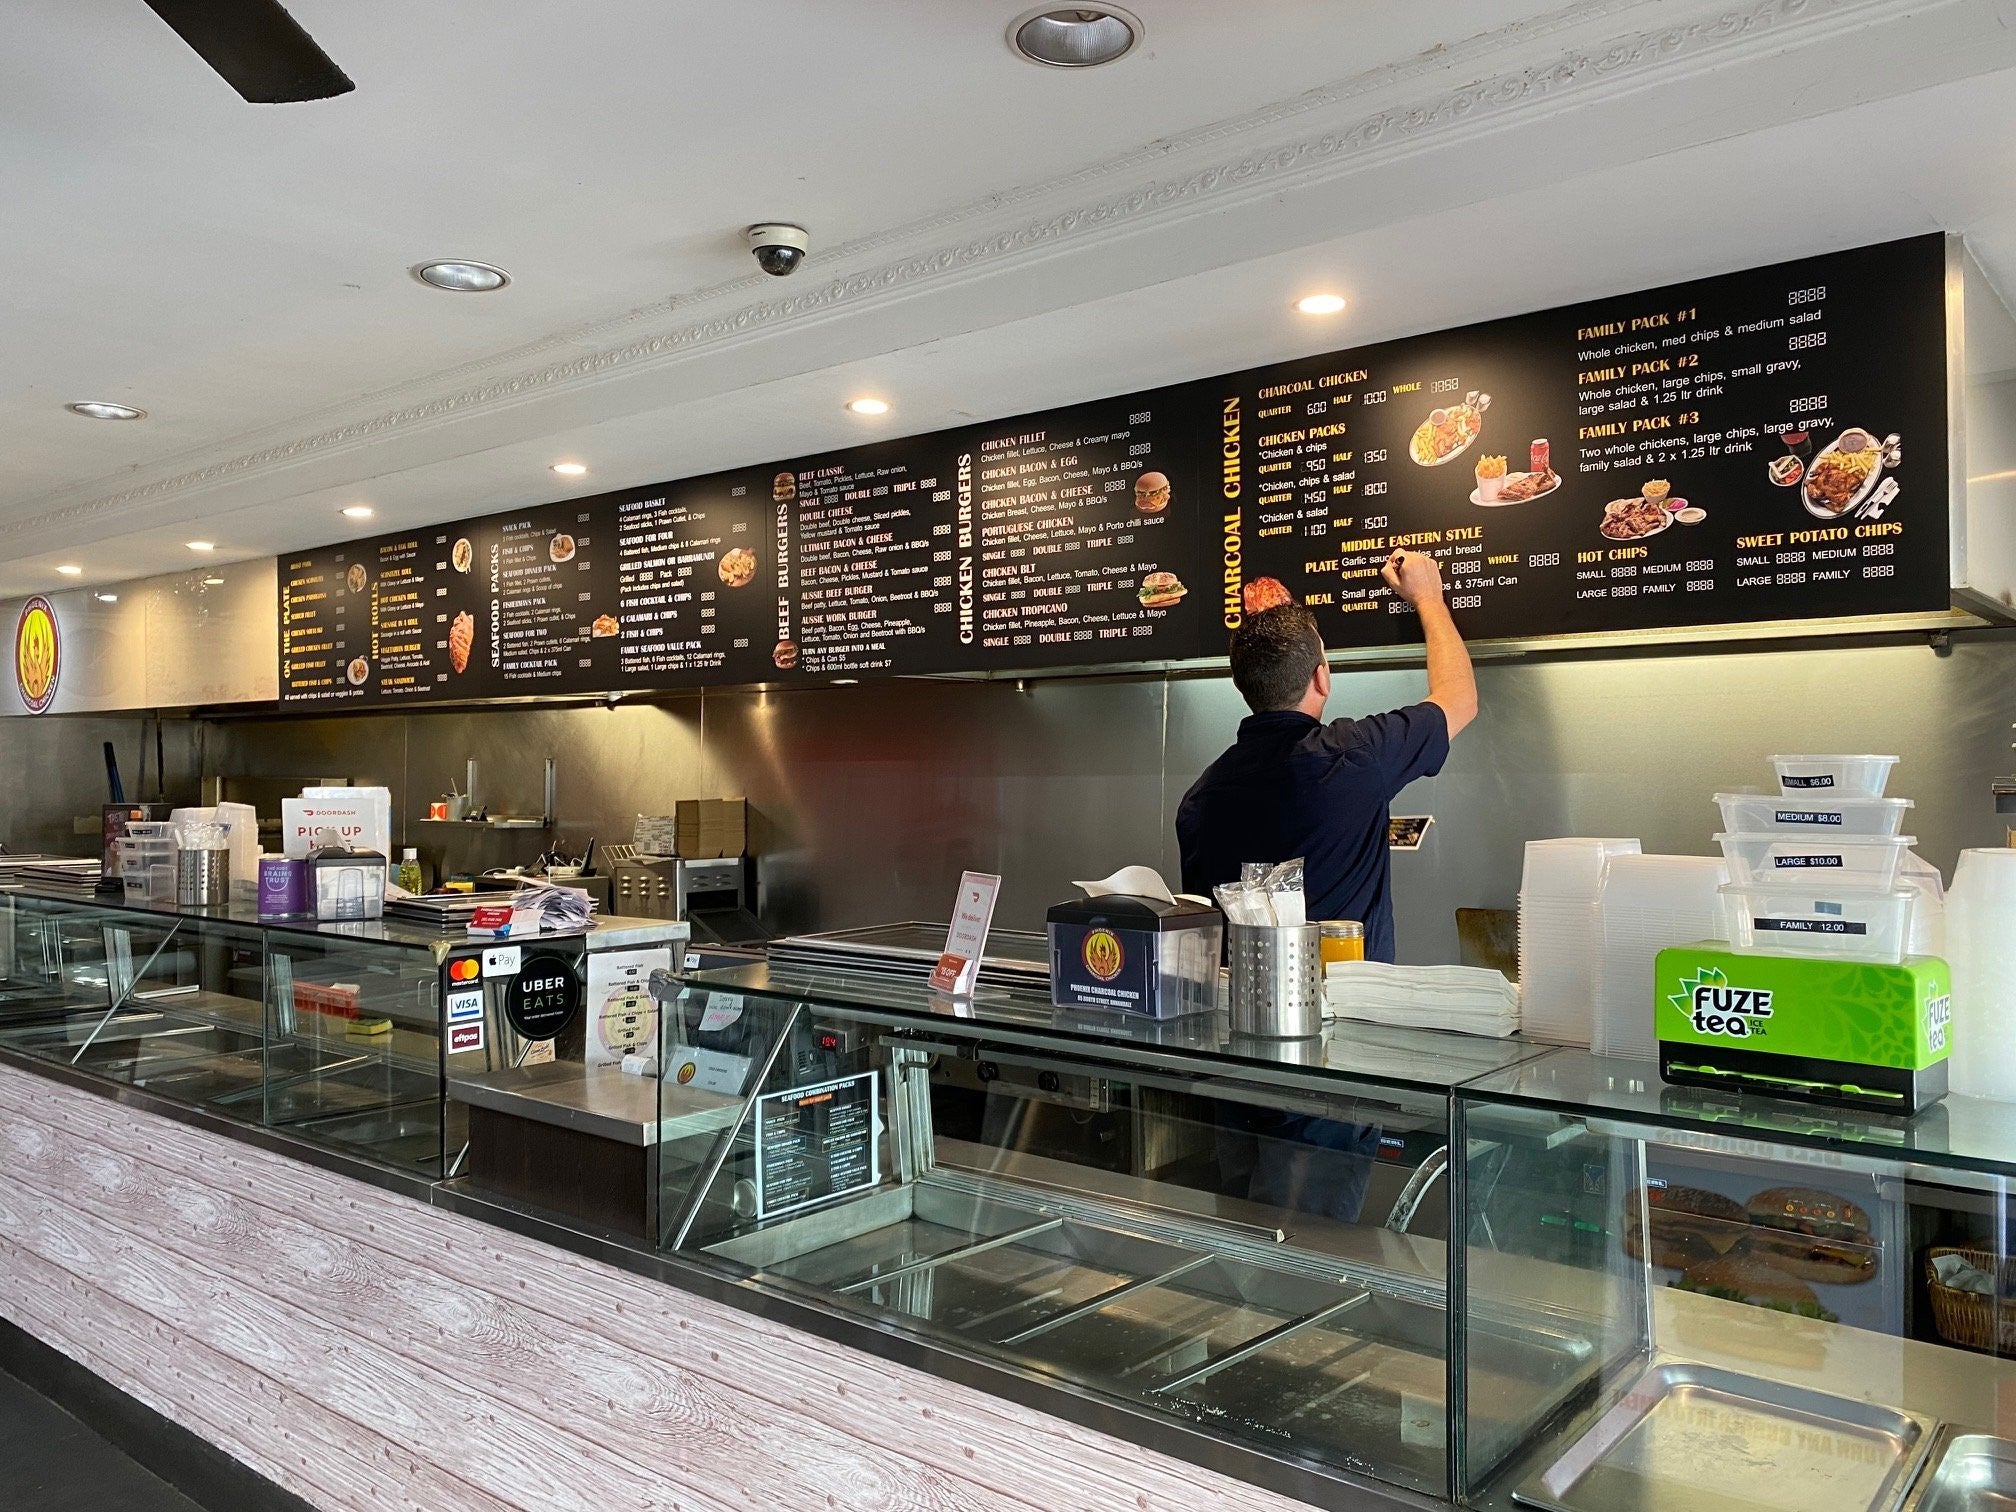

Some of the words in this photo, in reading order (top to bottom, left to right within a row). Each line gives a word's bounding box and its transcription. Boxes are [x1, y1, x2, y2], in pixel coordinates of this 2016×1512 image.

[1577, 320, 1626, 340] FAMILY
[1631, 313, 1670, 331] PACK
[1677, 308, 1697, 322] #1
[1578, 347, 1610, 362] Whole
[1615, 340, 1657, 358] chicken,
[1662, 332, 1687, 348] med
[1690, 328, 1720, 344] chips
[1724, 325, 1733, 336] &
[1738, 317, 1784, 335] medium
[1789, 310, 1822, 325] salad
[1578, 366, 1626, 384] FAMILY
[1632, 359, 1670, 376] PACK
[1678, 354, 1699, 367] #2
[1579, 388, 1611, 401] Whole
[1615, 381, 1658, 397] chicken,
[1662, 375, 1690, 390] large
[1694, 369, 1726, 385] chips,
[1731, 363, 1762, 378] small
[1766, 358, 1801, 374] gravy,
[1258, 381, 1314, 399] CHARCOAL
[1319, 370, 1367, 388] CHICKEN
[1258, 406, 1291, 419] QUARTER
[1333, 394, 1353, 405] HALF
[1393, 382, 1421, 394] WHOLE
[1579, 403, 1604, 416] large
[1608, 398, 1636, 411] salad
[1640, 396, 1649, 406] &
[1653, 391, 1677, 403] 1.25
[1681, 389, 1692, 400] ltr
[1696, 385, 1723, 398] drink
[1258, 429, 1306, 447] CHICKEN
[1309, 423, 1346, 439] PACKS
[1579, 422, 1628, 439] FAMILY
[1633, 415, 1671, 431] PACK
[1678, 411, 1699, 425] #3
[981, 436, 1016, 452] CHICKEN
[1019, 432, 1046, 445] FILLET
[1580, 447, 1601, 458] Two
[1605, 442, 1635, 454] whole
[1639, 434, 1689, 451] chickens,
[1693, 429, 1721, 444] large
[1726, 425, 1759, 440] chips,
[1764, 421, 1793, 436] large
[1798, 415, 1834, 431] gravy,
[1223, 397, 1240, 498] CHICKEN
[1296, 445, 1303, 454] &
[1306, 442, 1327, 455] chips
[1258, 462, 1292, 474] QUARTER
[1333, 451, 1353, 463] HALF
[1299, 477, 1320, 488] chips
[1323, 473, 1329, 482] &
[1333, 470, 1355, 483] salad
[958, 454, 972, 548] BURGERS
[1258, 493, 1292, 505] QUARTER
[1333, 483, 1353, 495] HALF
[1297, 510, 1303, 518] &
[1306, 506, 1328, 518] salad
[982, 521, 1034, 537] PORTUGUESE
[1037, 517, 1073, 530] CHICKEN
[1259, 525, 1292, 537] QUARTER
[1334, 518, 1353, 528] HALF
[1736, 534, 1783, 549] SWEET
[1790, 528, 1847, 544] POTATO
[1855, 522, 1902, 538] CHIPS
[777, 504, 789, 588] BURGERS
[1342, 537, 1385, 552] MIDDLE
[1389, 531, 1441, 547] EASTERN
[1446, 527, 1483, 541] STYLE
[1342, 555, 1366, 567] Garlic
[1435, 547, 1451, 557] and
[1455, 544, 1482, 555] bread
[1577, 549, 1603, 563] HOT
[1609, 547, 1648, 561] CHIPS
[490, 543, 499, 592] PACKS
[982, 566, 1018, 579] CHICKEN
[1021, 564, 1036, 575] BLT
[1223, 507, 1241, 629] CHARCOAL
[1306, 560, 1339, 574] PLATE
[1576, 568, 1606, 579] SMALL
[1642, 562, 1681, 574] MEDIUM
[1737, 574, 1771, 586] LARGE
[1813, 569, 1850, 581] FAMILY
[1342, 588, 1365, 600] Small
[1368, 586, 1392, 599] garlic
[1454, 580, 1462, 590] &
[1465, 577, 1494, 590] 375ml
[1497, 576, 1517, 586] Can
[959, 556, 974, 644] CHICKEN
[1306, 594, 1334, 606] MEAL
[779, 596, 789, 639] BEEF
[983, 607, 1018, 619] CHICKEN
[1021, 603, 1068, 615] TROPICANO
[491, 599, 500, 667] SEAFOOD
[284, 659, 290, 678] ON
[1785, 778, 1806, 786] SMALL
[1810, 778, 1831, 786] $6.00
[1778, 813, 1813, 821] MEDIUM
[342, 827, 361, 836] UP
[498, 955, 515, 967] Pay
[523, 977, 564, 992] UBER
[456, 998, 477, 1009] VISA
[524, 994, 564, 1010] EATS
[1696, 987, 1771, 1015] FUZE
[1693, 1011, 1746, 1035] tea
[1929, 997, 1949, 1028] FUZE
[454, 1033, 477, 1043] eftpos
[1930, 1027, 1943, 1051] tea
[782, 1092, 804, 1102] SEAFOOD
[806, 1085, 838, 1096] COMBINATION
[839, 1081, 855, 1089] PACKS
